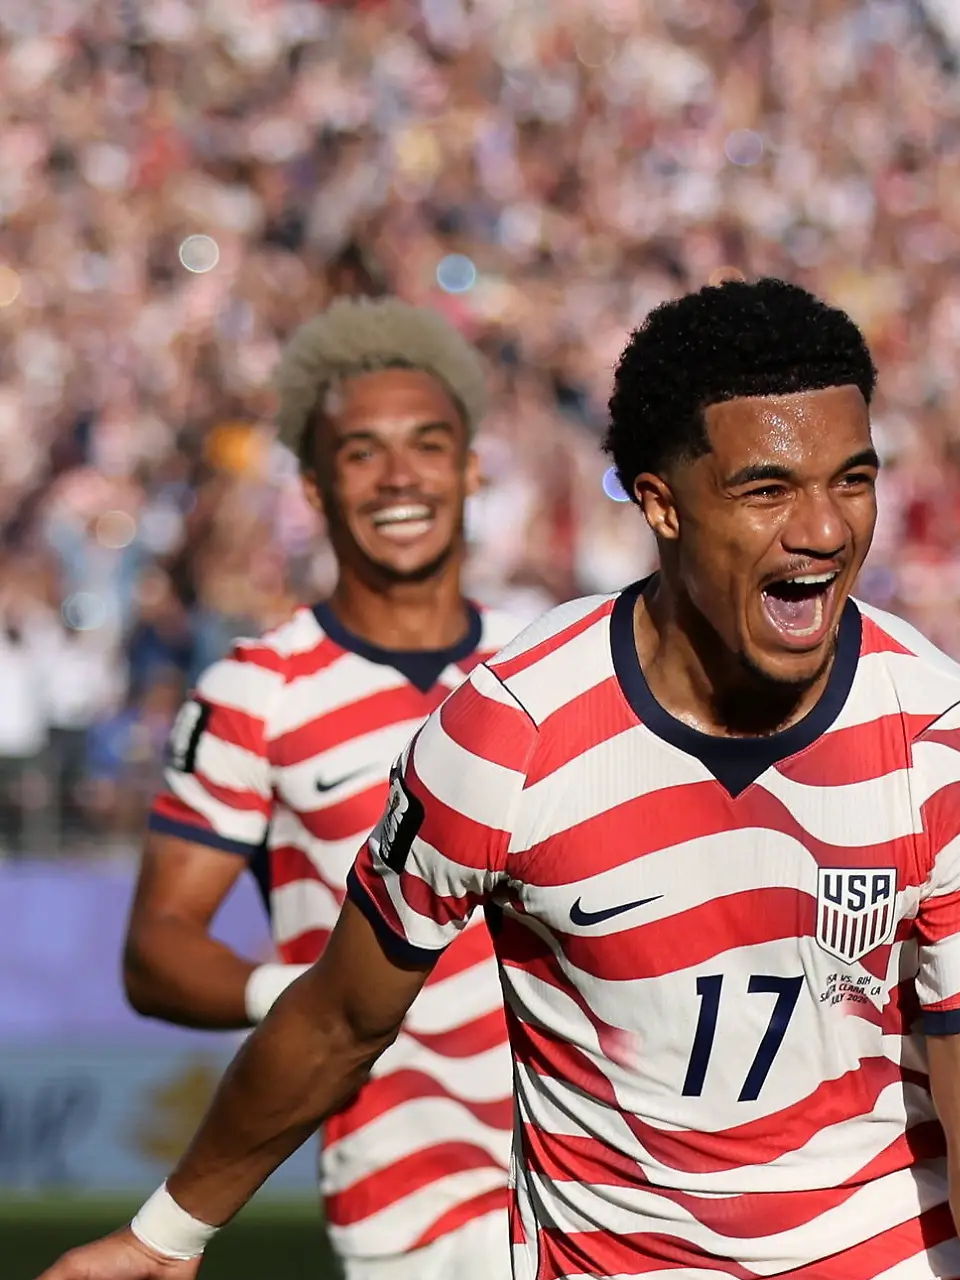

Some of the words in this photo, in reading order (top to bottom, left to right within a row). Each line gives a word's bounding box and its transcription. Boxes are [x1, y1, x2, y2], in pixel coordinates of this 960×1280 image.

[824, 874, 890, 912] USA
[827, 973, 837, 986] SA
[857, 975, 872, 985] BIH
[820, 984, 836, 1002] STA
[871, 986, 881, 996] CA
[830, 992, 845, 1007] ULY
[682, 974, 805, 1102] 17
